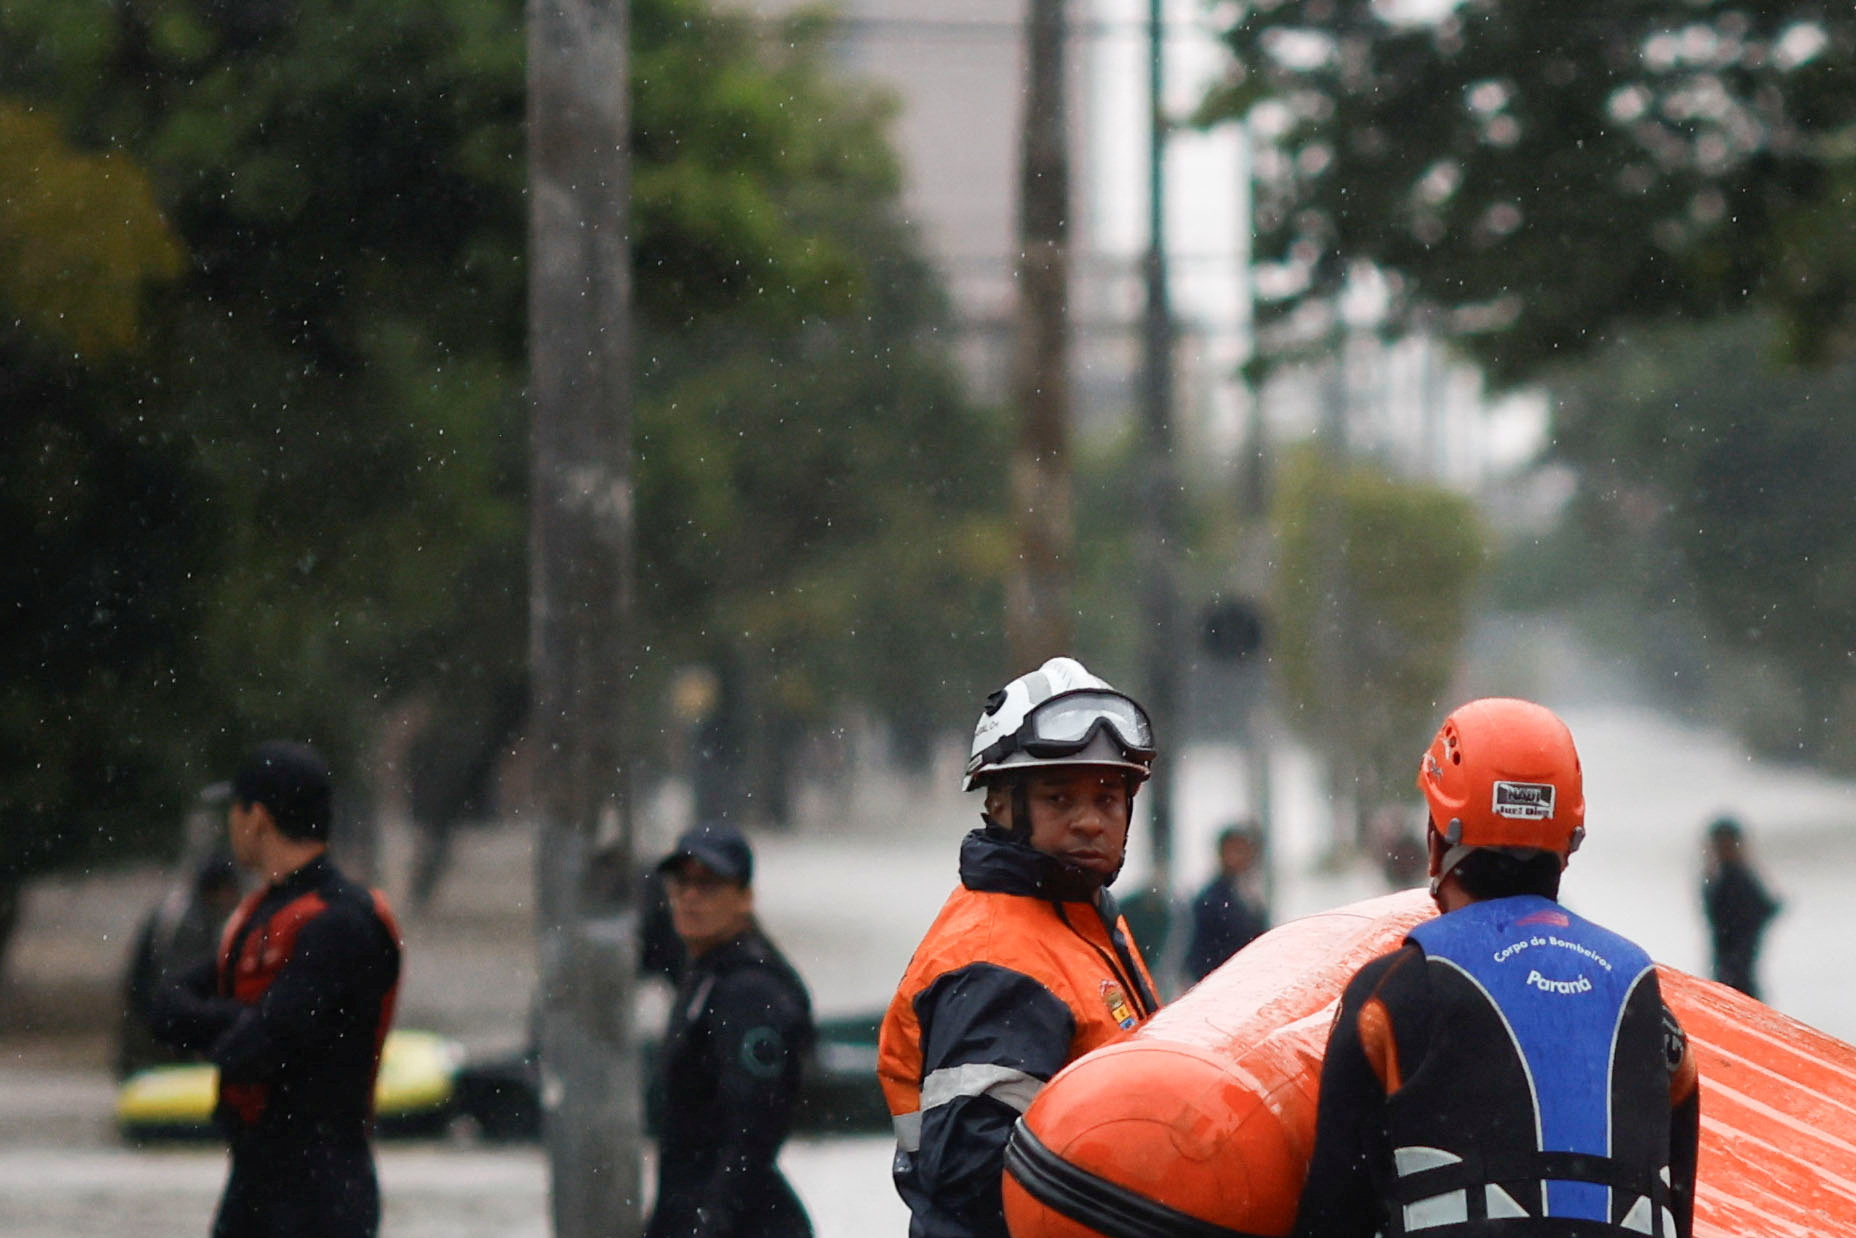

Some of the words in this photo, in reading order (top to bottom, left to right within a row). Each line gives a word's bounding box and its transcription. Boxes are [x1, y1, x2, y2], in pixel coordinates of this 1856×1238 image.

[1493, 941, 1528, 962] Corpo
[1530, 936, 1546, 946] de
[1548, 936, 1612, 971] Bombeiros
[1526, 970, 1592, 994] Paraná
